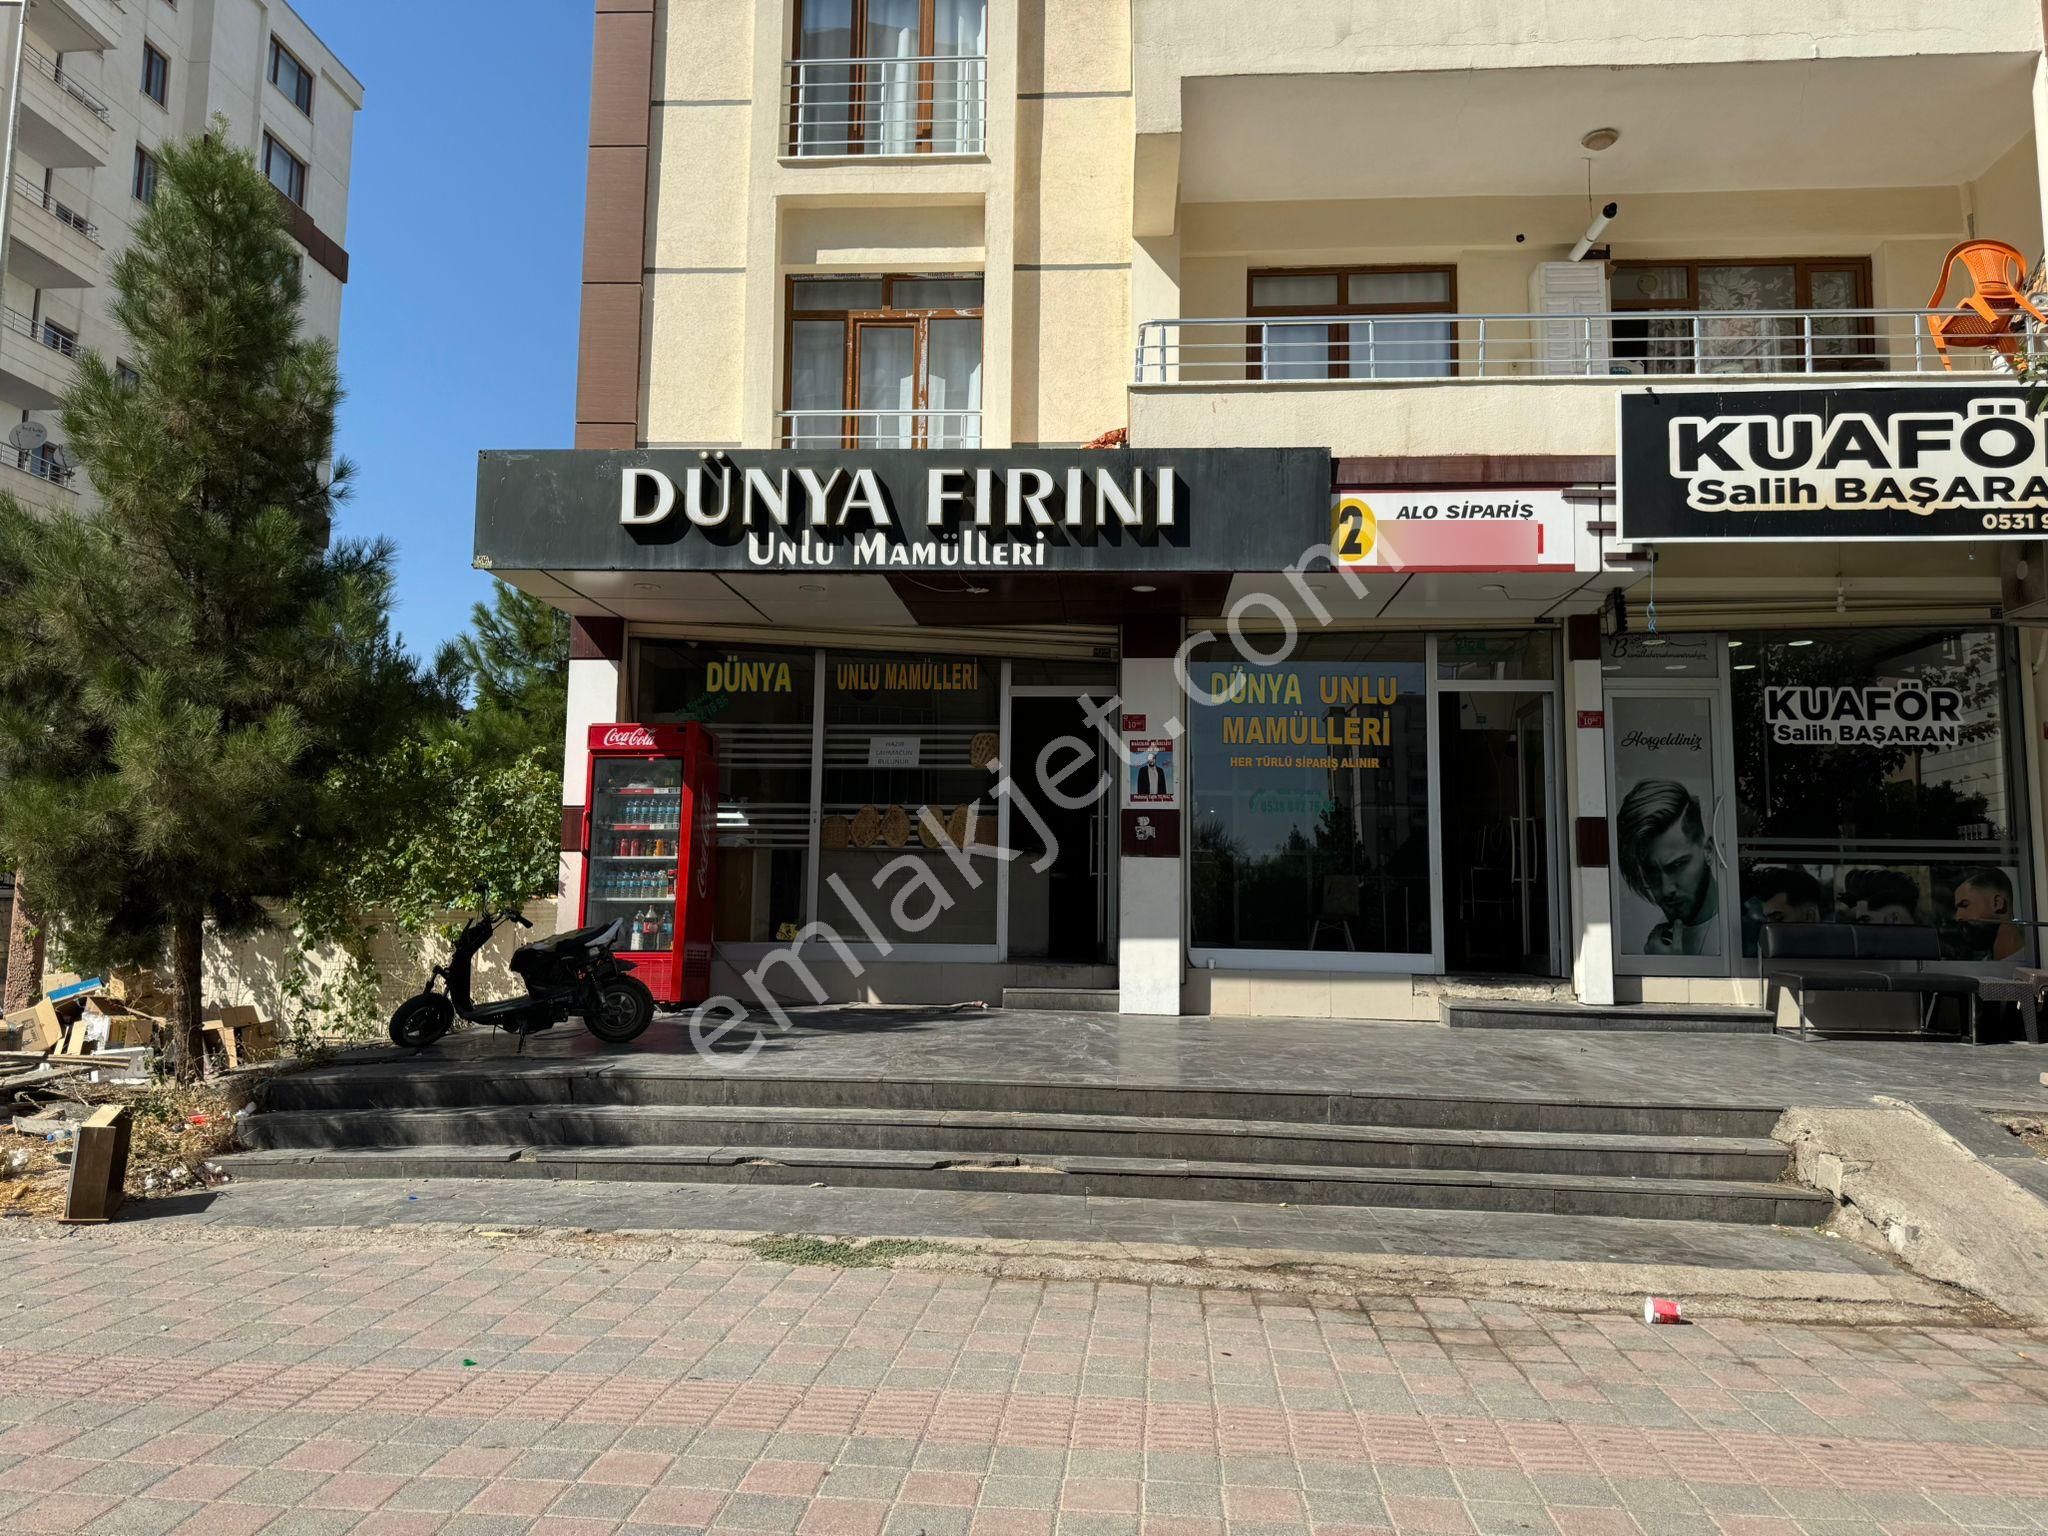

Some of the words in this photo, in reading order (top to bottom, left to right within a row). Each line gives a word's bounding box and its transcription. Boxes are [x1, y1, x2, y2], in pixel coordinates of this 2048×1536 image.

[1677, 404, 2048, 472] KUAFÖ
[619, 449, 891, 526] DÜNYA
[926, 466, 1176, 527] FIRINI
[1697, 477, 1818, 505] Salih
[1396, 505, 1439, 519] ALO
[1446, 499, 1534, 521] SİPARİŞ
[1982, 513, 2034, 530] 0531
[706, 655, 793, 693] DÜNYA
[837, 663, 881, 690] UNLU
[884, 657, 979, 691] MAMÜLLERİ
[1210, 665, 1302, 705] DÜNYA
[1319, 676, 1398, 705] UNLU
[1768, 682, 1961, 722] KUAFÖR
[1223, 710, 1391, 747] MAMÜLLERİ
[1778, 724, 1833, 742] Salih
[1839, 725, 1956, 744] BAŞARAN
[1230, 757, 1253, 767] HER
[1256, 755, 1293, 768] TÜRLÜ
[1295, 755, 1339, 771] SİPARİŞ
[1341, 757, 1380, 768] ALINIR
